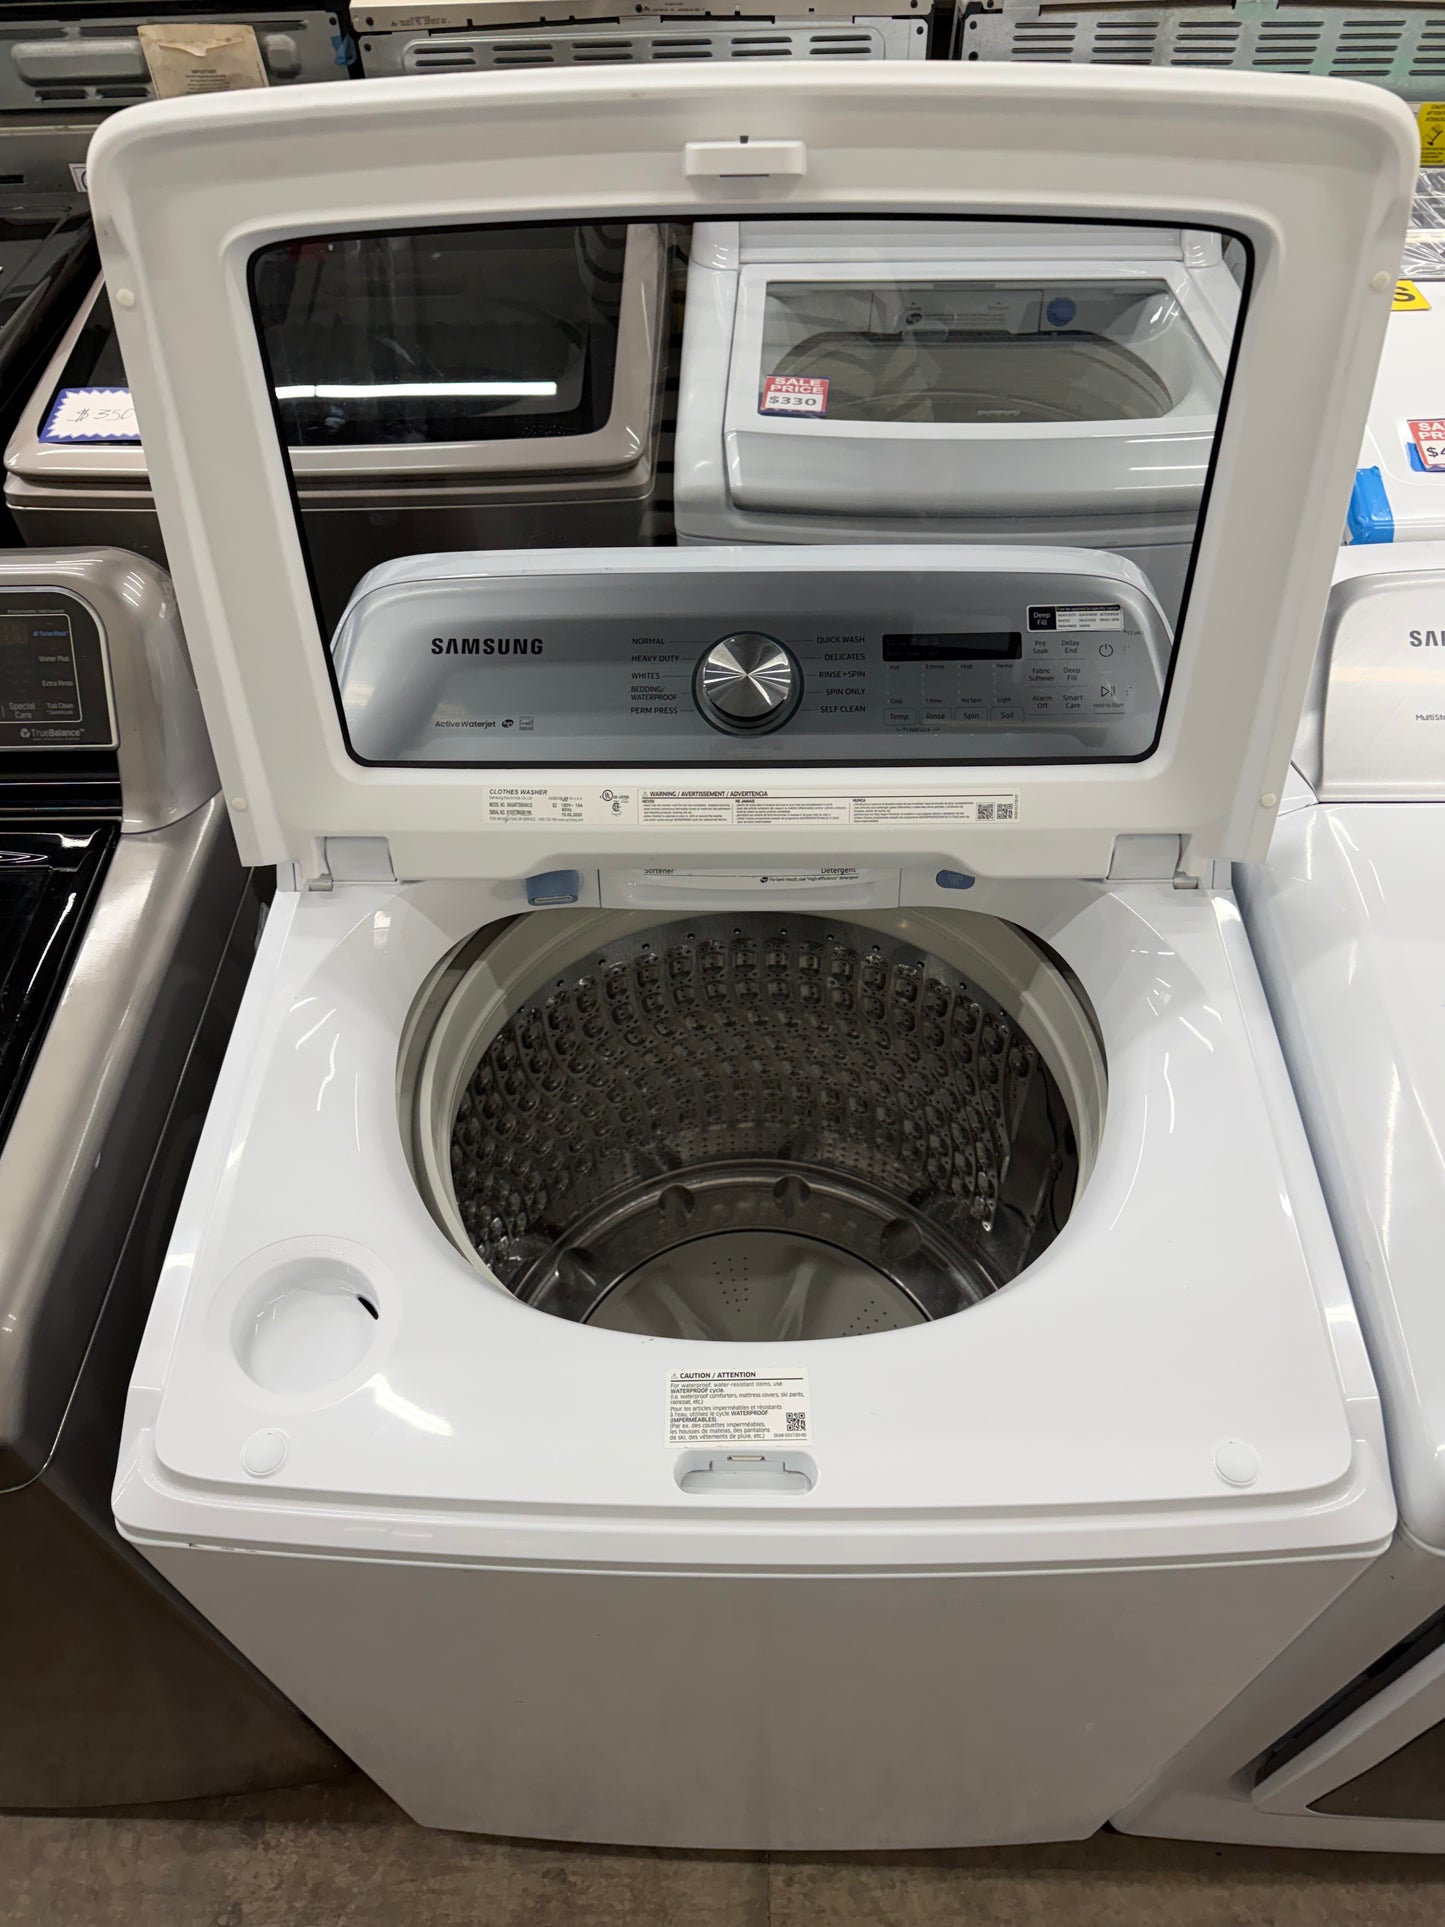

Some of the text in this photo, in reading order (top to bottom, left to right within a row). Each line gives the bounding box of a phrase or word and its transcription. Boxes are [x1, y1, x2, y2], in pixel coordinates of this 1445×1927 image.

[774, 378, 821, 386] SALE
[770, 384, 824, 394] PRICE
[769, 396, 817, 406] $330
[1418, 422, 1445, 431] SA
[1418, 432, 1445, 440] PR
[816, 636, 840, 644] QUICK
[1409, 630, 1445, 647] SA
[431, 638, 544, 655] SAMSUNG
[15, 711, 32, 719] Care
[890, 713, 911, 721] Temp.
[963, 712, 979, 720] Spin
